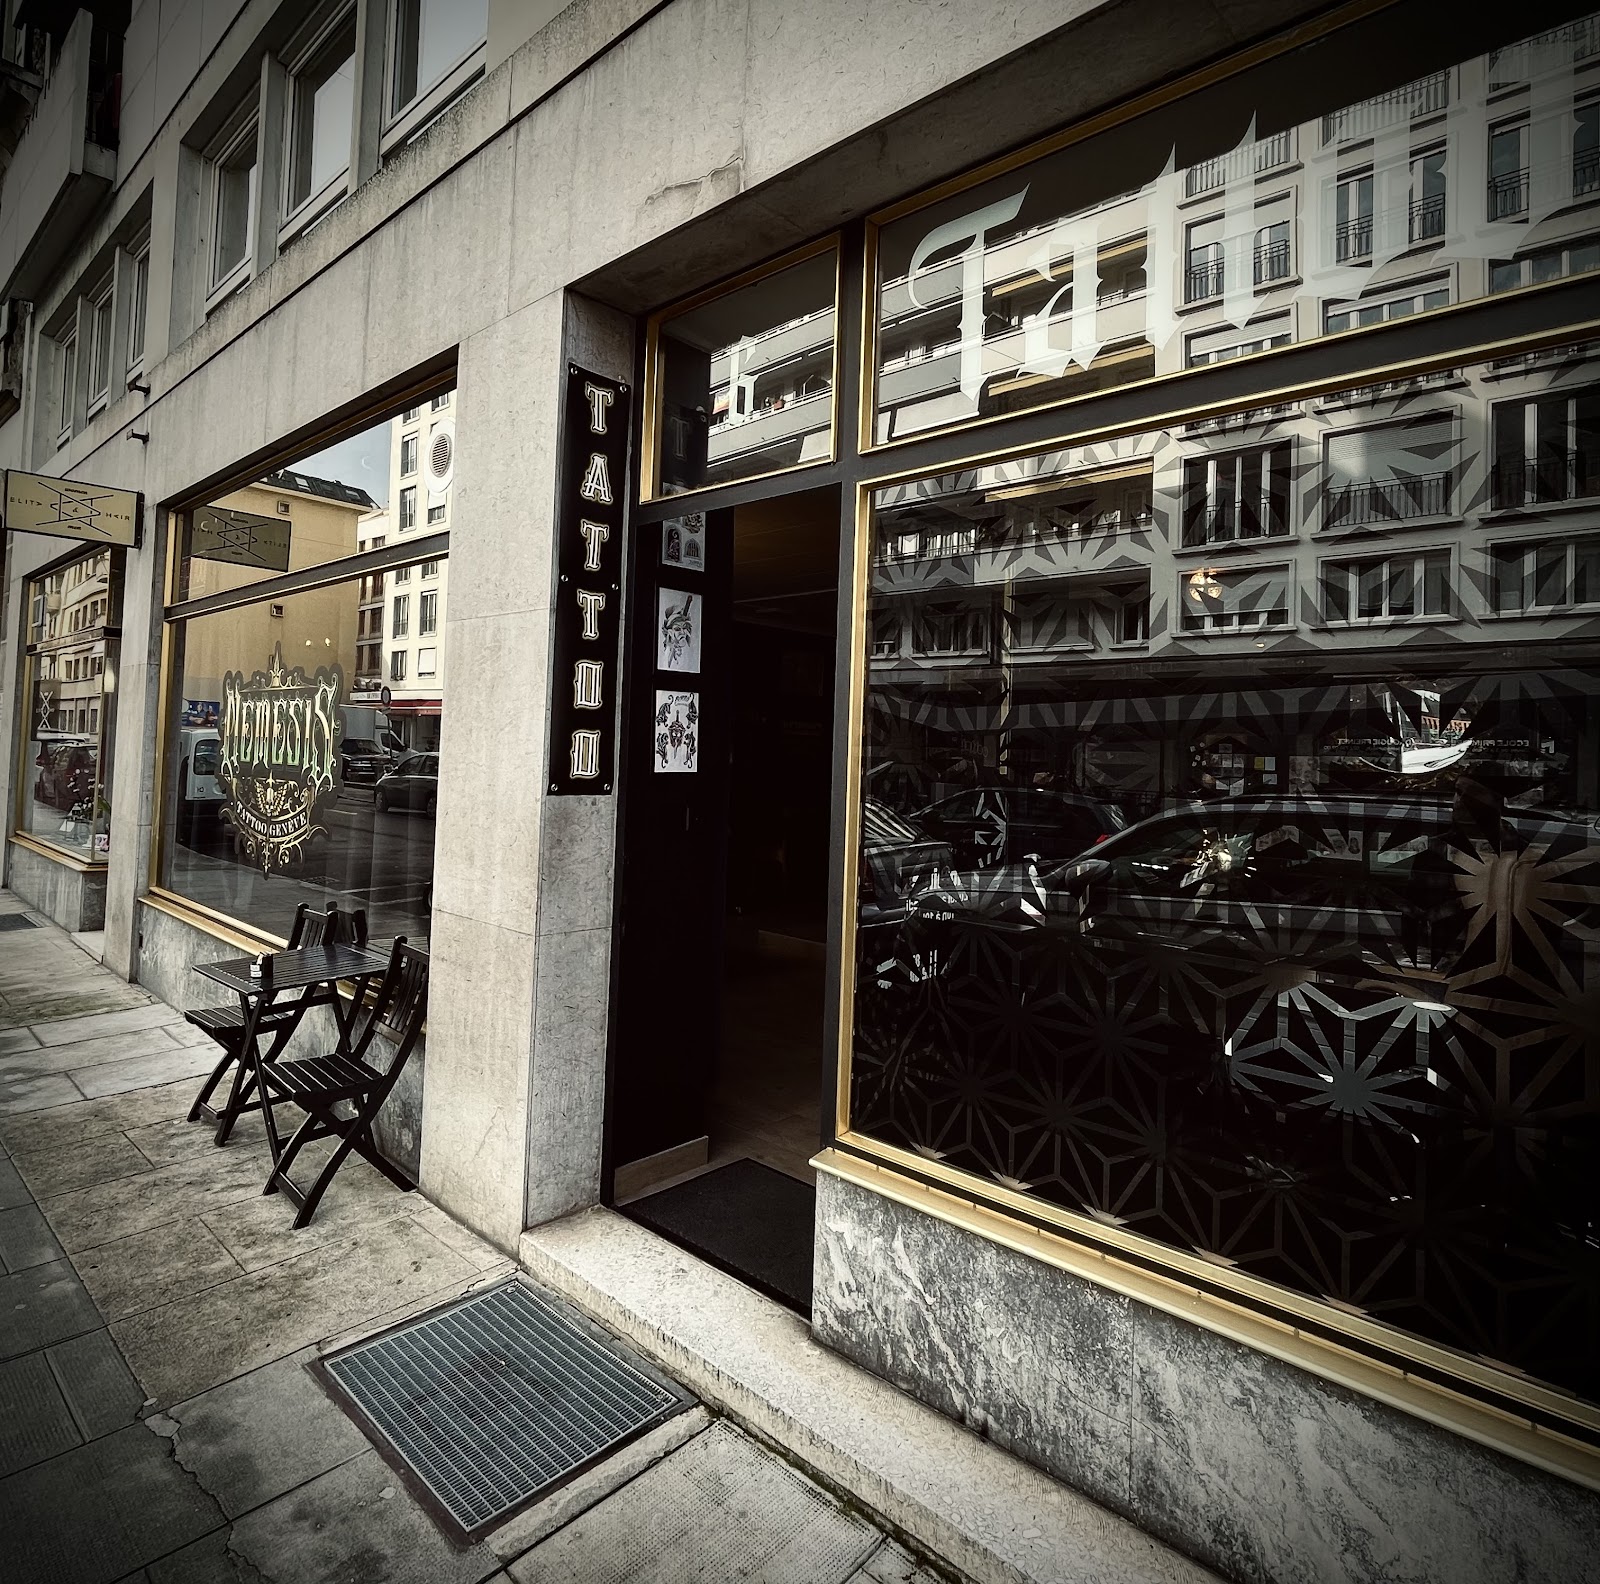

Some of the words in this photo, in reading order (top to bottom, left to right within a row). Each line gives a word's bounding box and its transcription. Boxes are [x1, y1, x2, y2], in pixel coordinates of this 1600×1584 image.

[105, 512, 131, 521] HAIR
[571, 382, 615, 780] TATTOO
[220, 672, 341, 793] NEMESIS
[236, 800, 267, 834] TATTOO
[269, 812, 307, 836] GENÈVE
